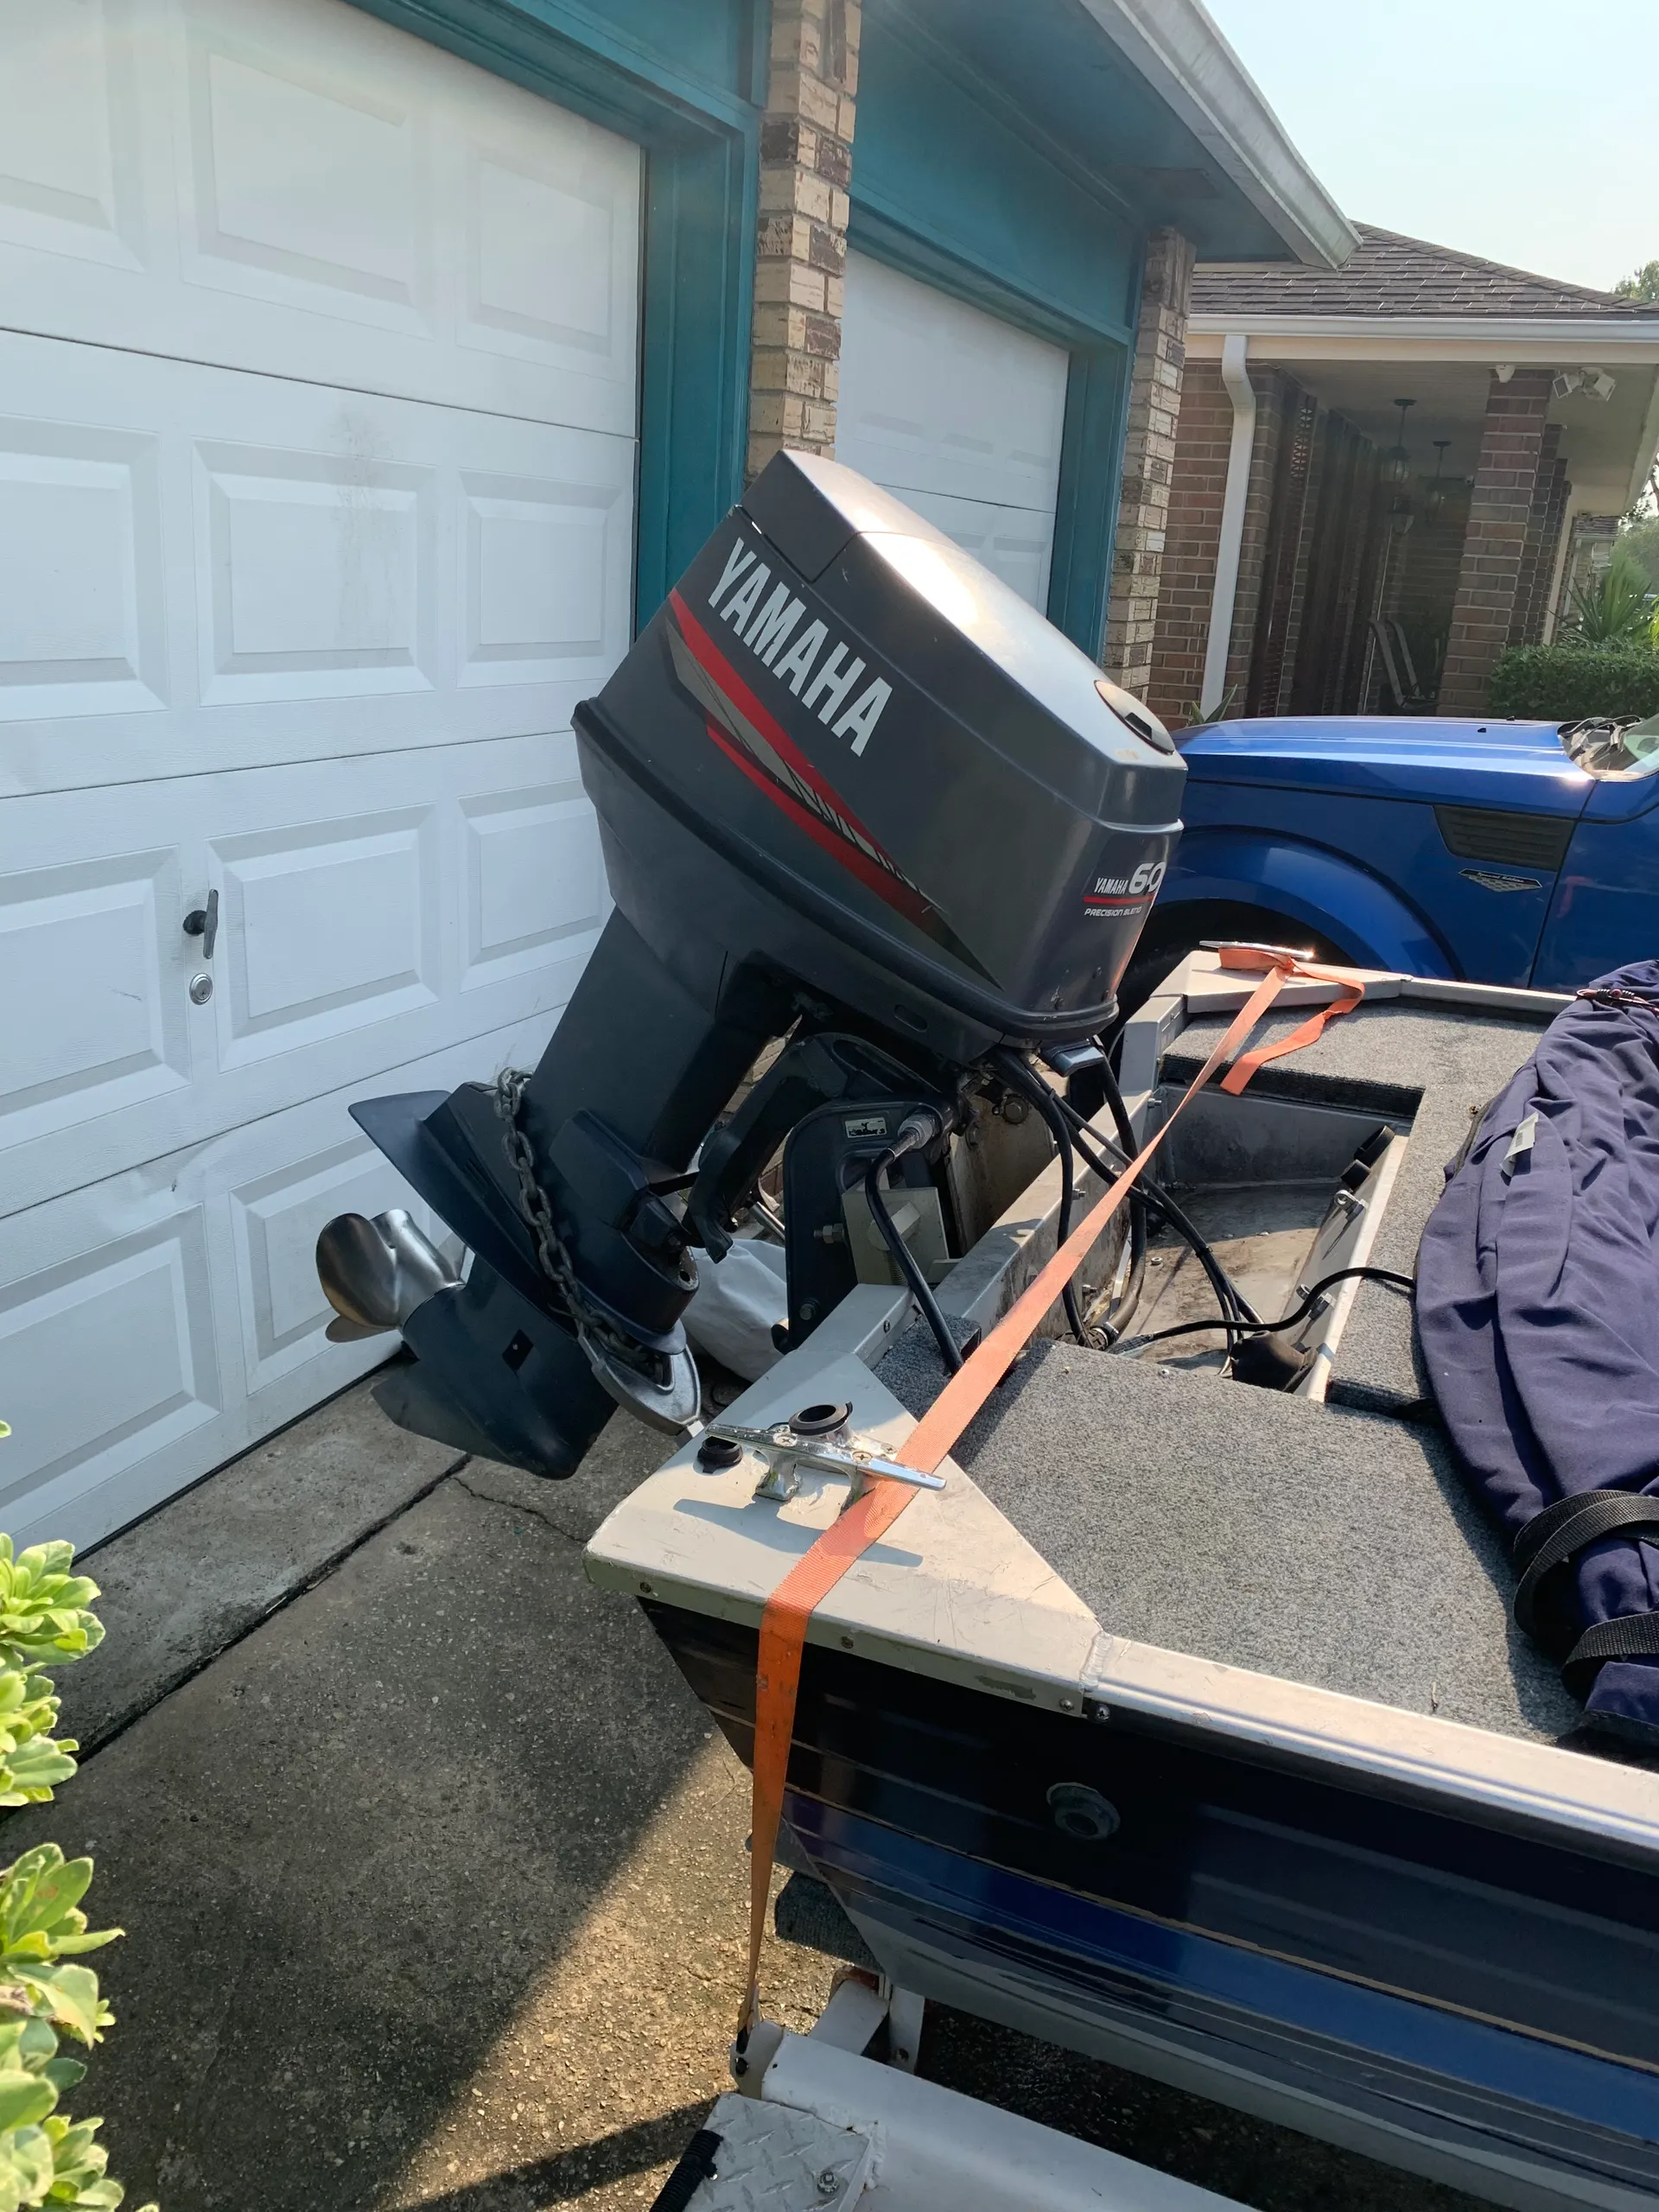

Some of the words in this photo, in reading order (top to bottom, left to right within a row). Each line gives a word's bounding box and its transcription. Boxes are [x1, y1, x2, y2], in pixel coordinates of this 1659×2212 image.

[708, 537, 893, 757] YAMAHA
[1094, 877, 1128, 894] YAMAHA
[1128, 861, 1166, 893] 60
[1084, 907, 1123, 917] PRECISION
